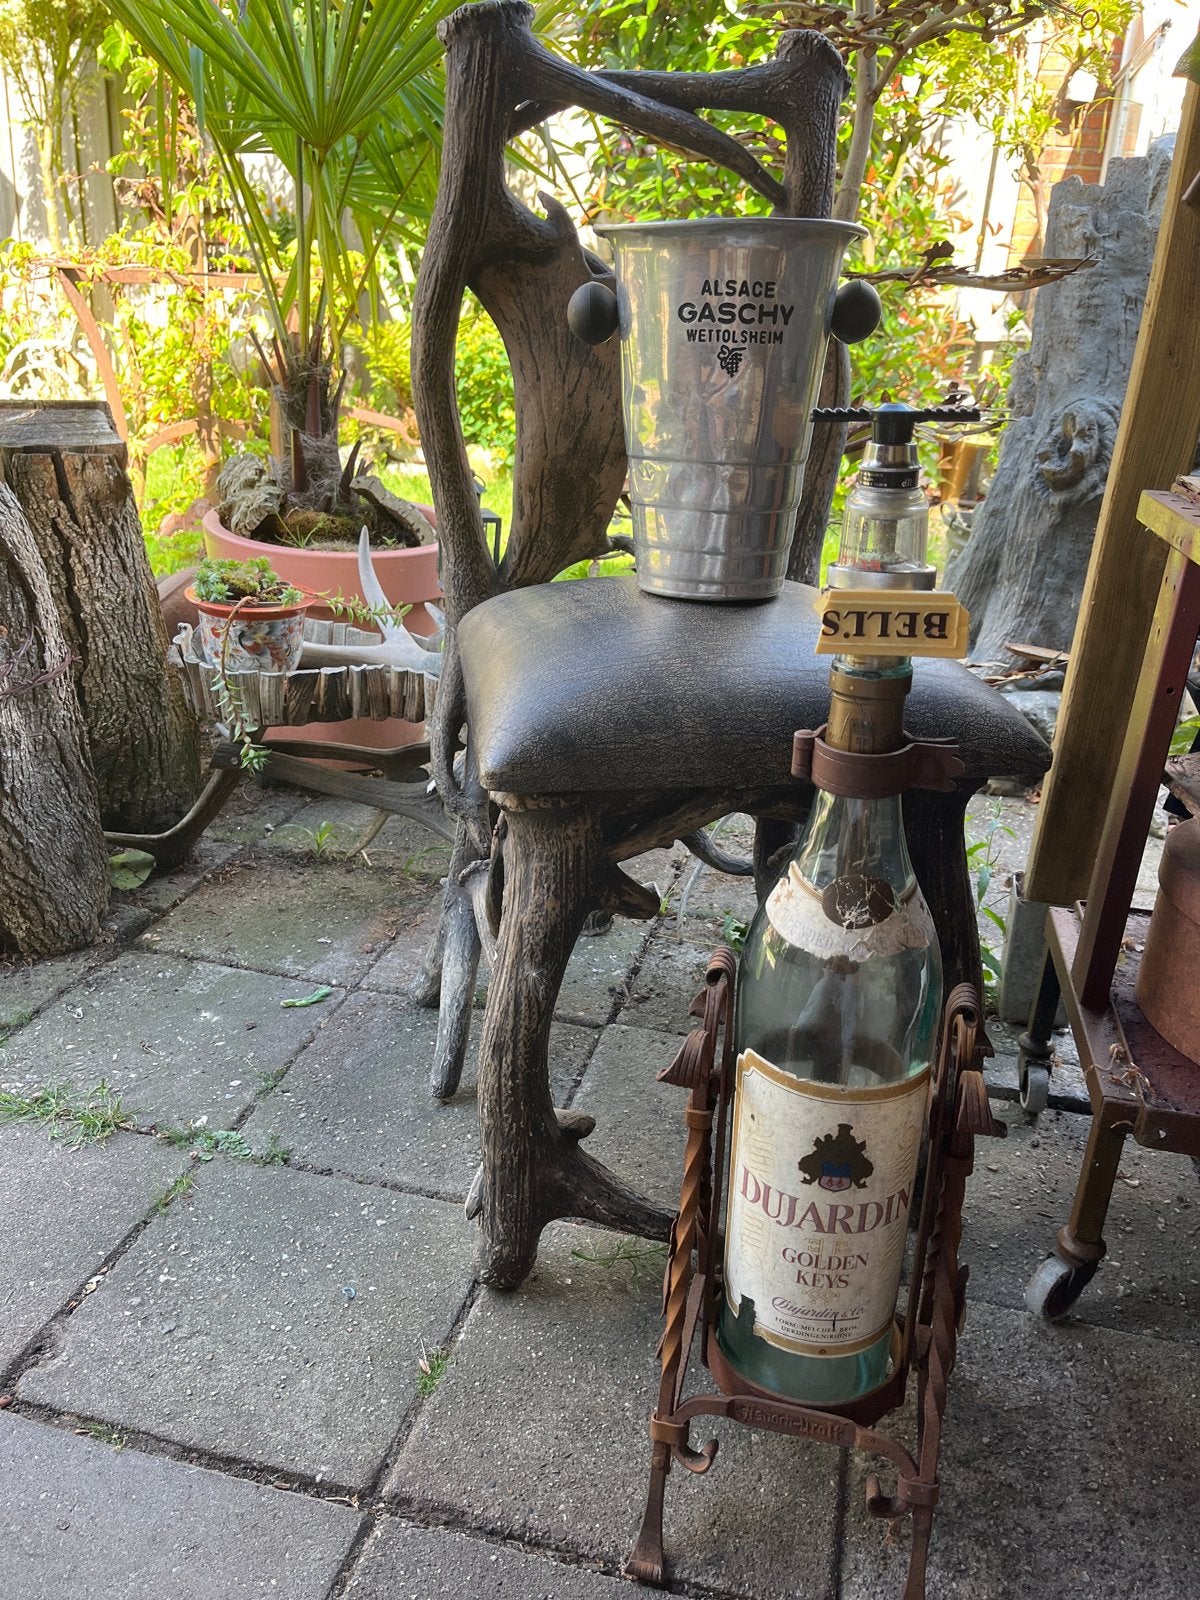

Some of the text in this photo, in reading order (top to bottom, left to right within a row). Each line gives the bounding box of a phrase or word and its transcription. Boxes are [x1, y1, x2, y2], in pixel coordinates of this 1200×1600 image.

[701, 279, 776, 298] ALSACE
[678, 302, 795, 326] GASCHY
[686, 328, 784, 345] WETTOLSHEIM
[821, 610, 950, 640] BELL'S
[740, 1165, 912, 1235] DUJARDIN
[782, 1247, 870, 1271] GOLDEN
[796, 1269, 850, 1289] KEYS
[771, 1296, 839, 1320] Dujardin
